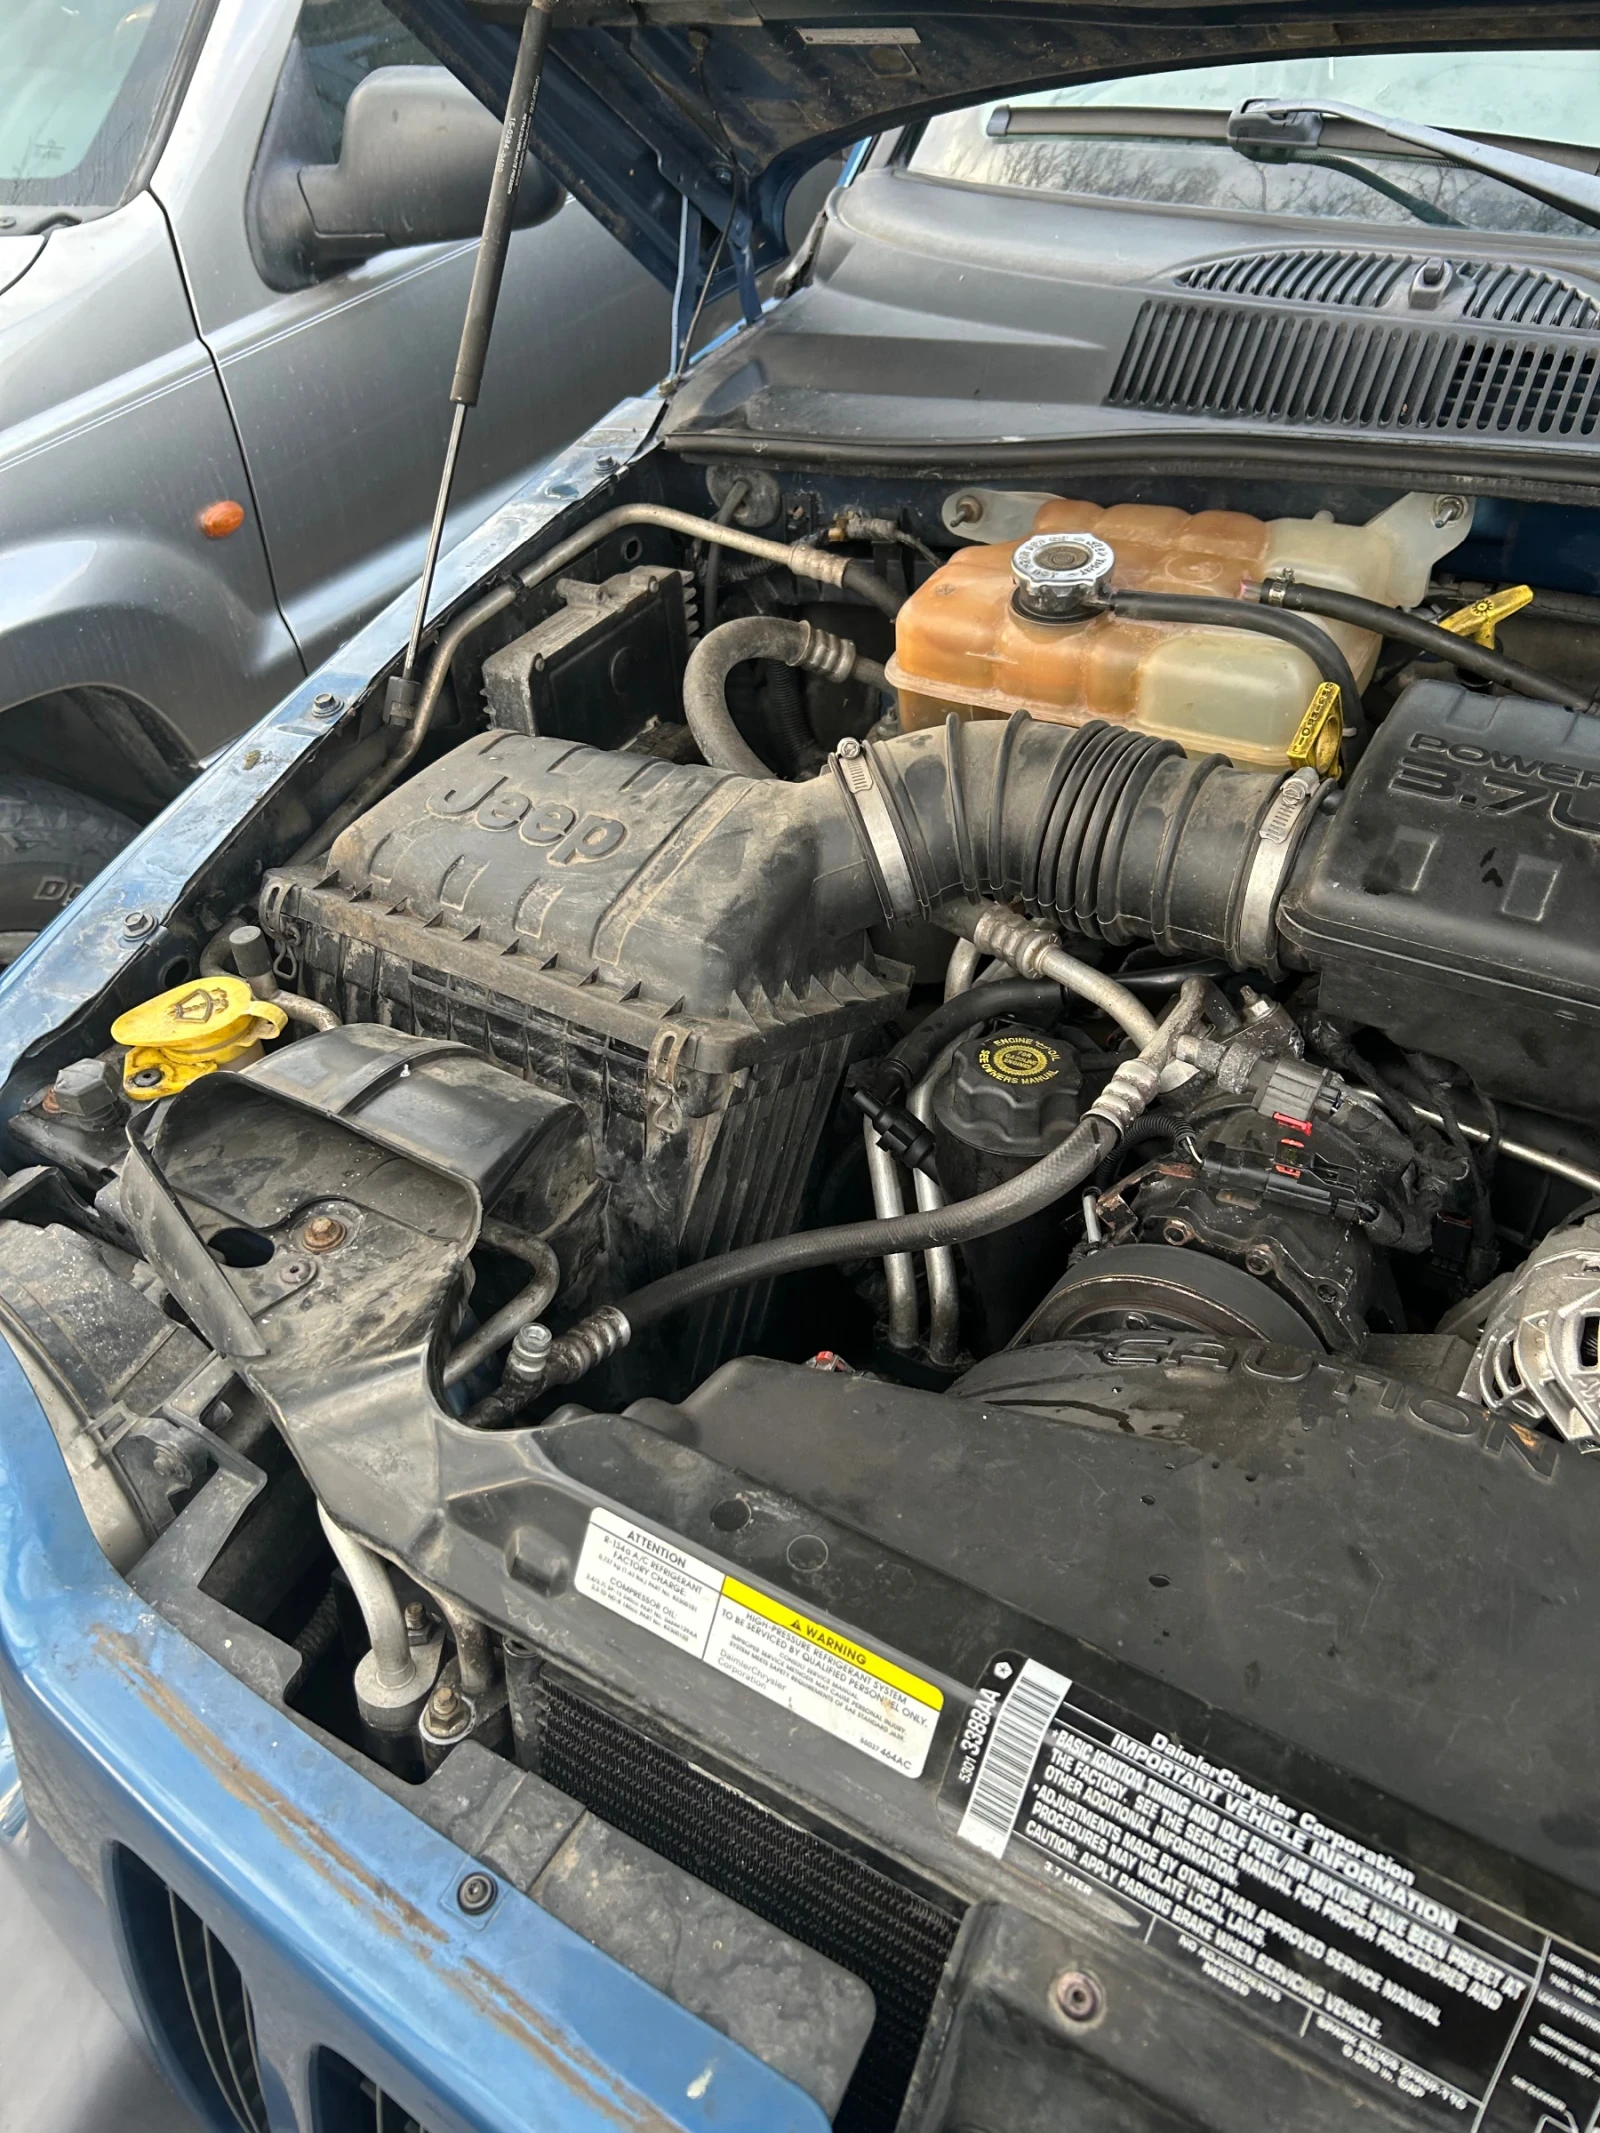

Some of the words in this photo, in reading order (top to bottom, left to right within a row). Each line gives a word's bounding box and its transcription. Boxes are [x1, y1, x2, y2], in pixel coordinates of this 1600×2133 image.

[427, 775, 630, 866] Jeep
[979, 1049, 990, 1064] SEE
[982, 1063, 1018, 1084] OWNERS
[993, 1038, 1034, 1047] ENGINE
[1048, 1049, 1060, 1062] OIL
[1022, 1069, 1059, 1084] MANUAL
[1100, 1336, 1559, 1483] CAUTION
[603, 1535, 631, 1555] R-134a
[632, 1551, 648, 1564] A/C
[650, 1560, 702, 1593] REFRIGERANT
[612, 1550, 649, 1575] FACTORY
[626, 1530, 686, 1568] ATTENTION
[609, 1576, 660, 1609] COMPRESSOR
[719, 1648, 786, 1690] DaimlerChrysler
[722, 1608, 733, 1620] TO
[734, 1615, 744, 1626] BE
[745, 1622, 787, 1649] SERVICED
[788, 1644, 800, 1656] BY
[801, 1652, 846, 1681] QUALIFIED
[901, 1707, 927, 1727] ONLY.
[745, 1612, 811, 1652] HIGH-PRESSURE
[812, 1647, 871, 1684] REFRIGERANT
[872, 1680, 907, 1704] SYSTEM
[778, 1652, 805, 1670] CONSULT
[806, 1667, 830, 1684] SERVICE
[806, 1624, 866, 1665] WARNING
[717, 1656, 766, 1689] Corporation
[730, 1633, 759, 1652] IMPROPER
[760, 1650, 784, 1666] SERVICE
[785, 1664, 813, 1683] METHODS
[814, 1680, 829, 1690] MAY
[829, 1688, 850, 1703] CAUSE
[850, 1700, 882, 1721] PERSONAL
[834, 1699, 843, 1707] OF
[856, 1711, 888, 1732] STANDARD
[960, 1688, 1001, 1756] 3388AA
[879, 1748, 911, 1769] 464AC
[958, 1756, 976, 1784] 5301
[1044, 1764, 1083, 1797] OTHER
[1081, 1786, 1150, 1836] ADDITIONAL
[1152, 1733, 1296, 1818] DaimlerChrysler
[1300, 1812, 1416, 1886] Corporation
[1110, 1732, 1223, 1802] IMPORTANT
[1225, 1793, 1308, 1850] VEHICLE
[1309, 1840, 1458, 1933] INFORMATION
[1031, 1800, 1108, 1854] PROCEDURES
[1107, 1843, 1137, 1870] MAY
[1137, 1859, 1187, 1900] VIOLATE
[1185, 1888, 1224, 1923] LOCAL
[1044, 1861, 1064, 1878] 3.7
[1064, 1871, 1092, 1896] LITER
[1050, 1746, 1074, 1771] THE
[1073, 1760, 1128, 1802] FACTORY.
[1133, 1794, 1159, 1819] SEE
[1160, 1807, 1185, 1833] THE
[1184, 1822, 1238, 1863] SERVICE
[1237, 1851, 1292, 1895] MANUAL
[1293, 1883, 1322, 1911] FOR
[1321, 1898, 1377, 1941] PROPER
[1375, 1928, 1468, 1992] PROCEDURES
[1466, 1980, 1502, 2010] AND
[1053, 1729, 1093, 1764] BASIC
[1089, 1748, 1146, 1791] IGNITION
[1142, 1777, 1191, 1815] TIMING
[1187, 1803, 1220, 1831] AND
[1217, 1818, 1250, 1848] IDLE
[1247, 1834, 1310, 1882] FUEL/AIR
[1307, 1868, 1371, 1915] MIXTURE
[1368, 1901, 1409, 1937] HAVE
[1406, 1922, 1449, 1959] BEEN
[1446, 1944, 1505, 1994] PRESET
[1500, 1974, 1526, 2000] AT
[1025, 1819, 1078, 1860] CAUTION:
[1078, 1851, 1118, 1882] APPLY
[1117, 1872, 1172, 1915] PARKING
[1171, 1904, 1215, 1940] BRAKE
[1214, 1928, 1256, 1964] WHEN
[1254, 1953, 1325, 2004] SERVICING
[1036, 1784, 1122, 1842] ADJUSTMENTS
[1121, 1831, 1159, 1863] MADE
[1158, 1852, 1178, 1873] BY
[1177, 1864, 1220, 1899] OTHER
[1220, 1886, 1256, 1919] THAN
[1254, 1908, 1325, 1959] APPROVED
[1324, 1947, 1383, 1992] SERVICE
[1381, 1979, 1440, 2026] MANUAL
[1178, 1934, 1197, 1952] NO
[1197, 1946, 1280, 2002] ADJUSTMENTS
[1202, 1960, 1249, 1996] NEEDED
